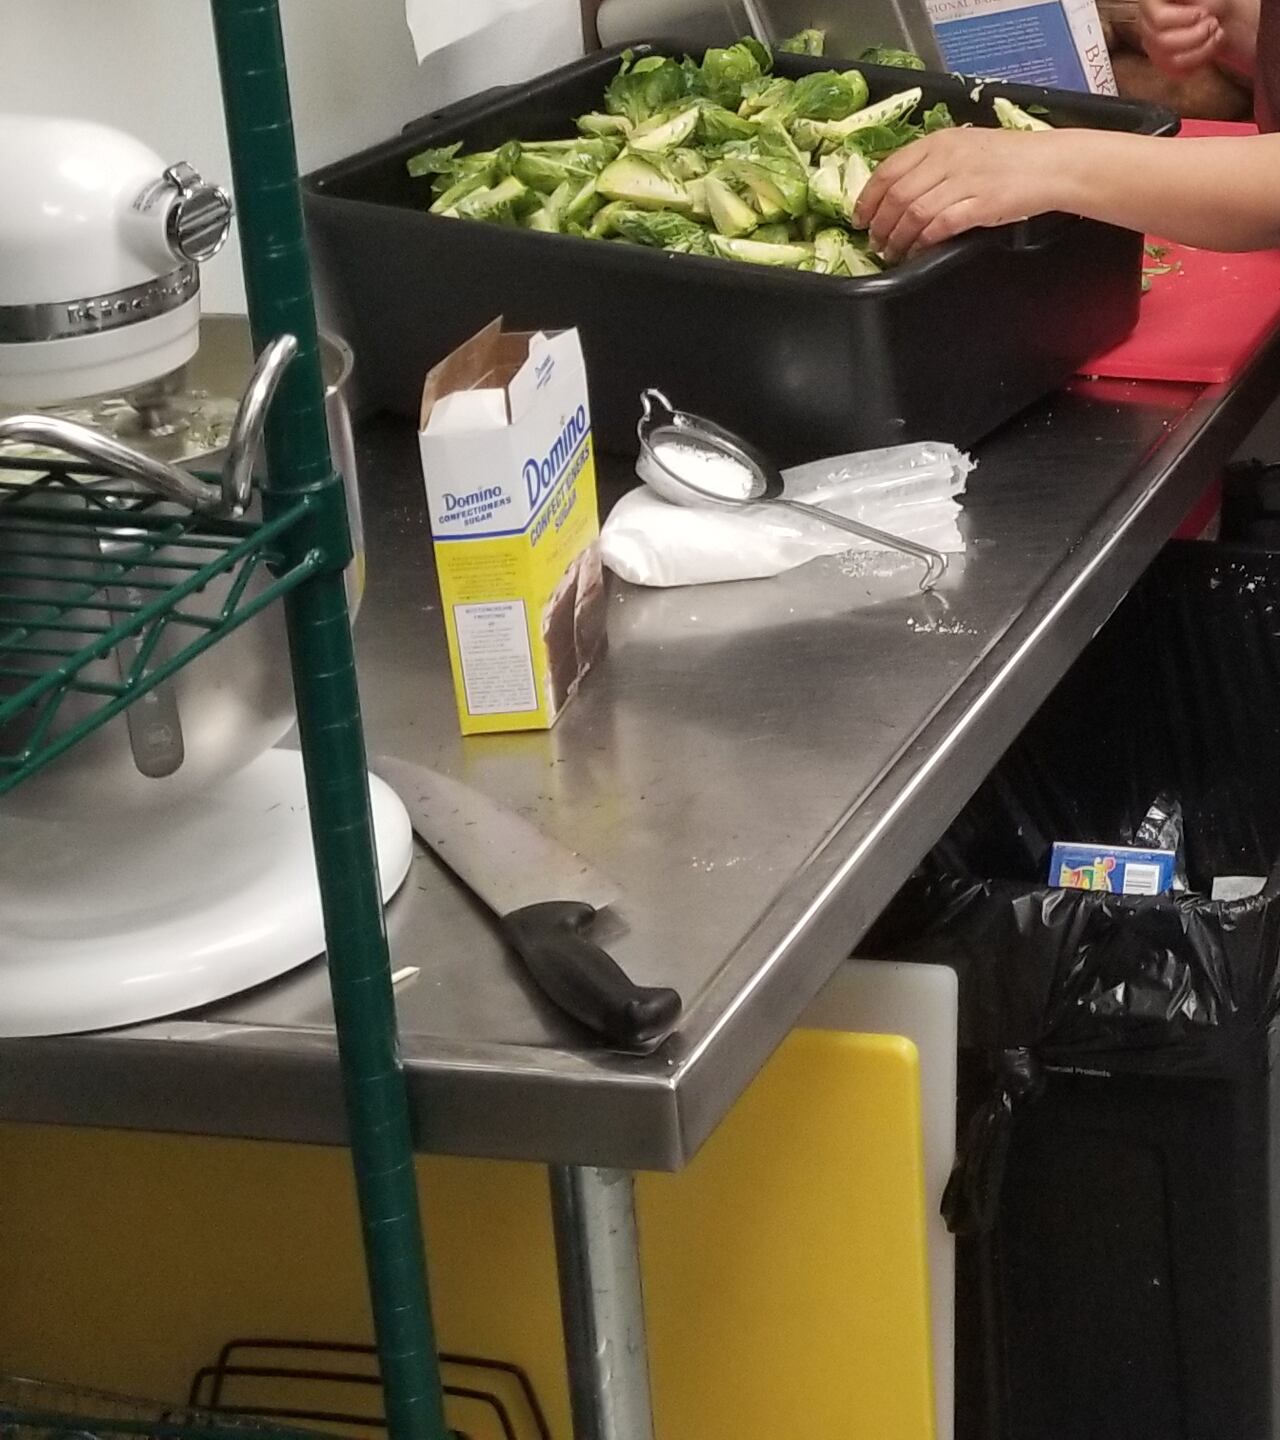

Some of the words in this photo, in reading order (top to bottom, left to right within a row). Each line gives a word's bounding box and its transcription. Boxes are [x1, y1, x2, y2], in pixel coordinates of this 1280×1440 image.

[927, 0, 969, 14] SIONAL
[1085, 44, 1112, 96] BAK
[522, 404, 586, 511] Domino
[438, 496, 512, 524] CONFECTIONERS
[442, 484, 502, 512] Domino
[464, 511, 493, 527] SUGAR
